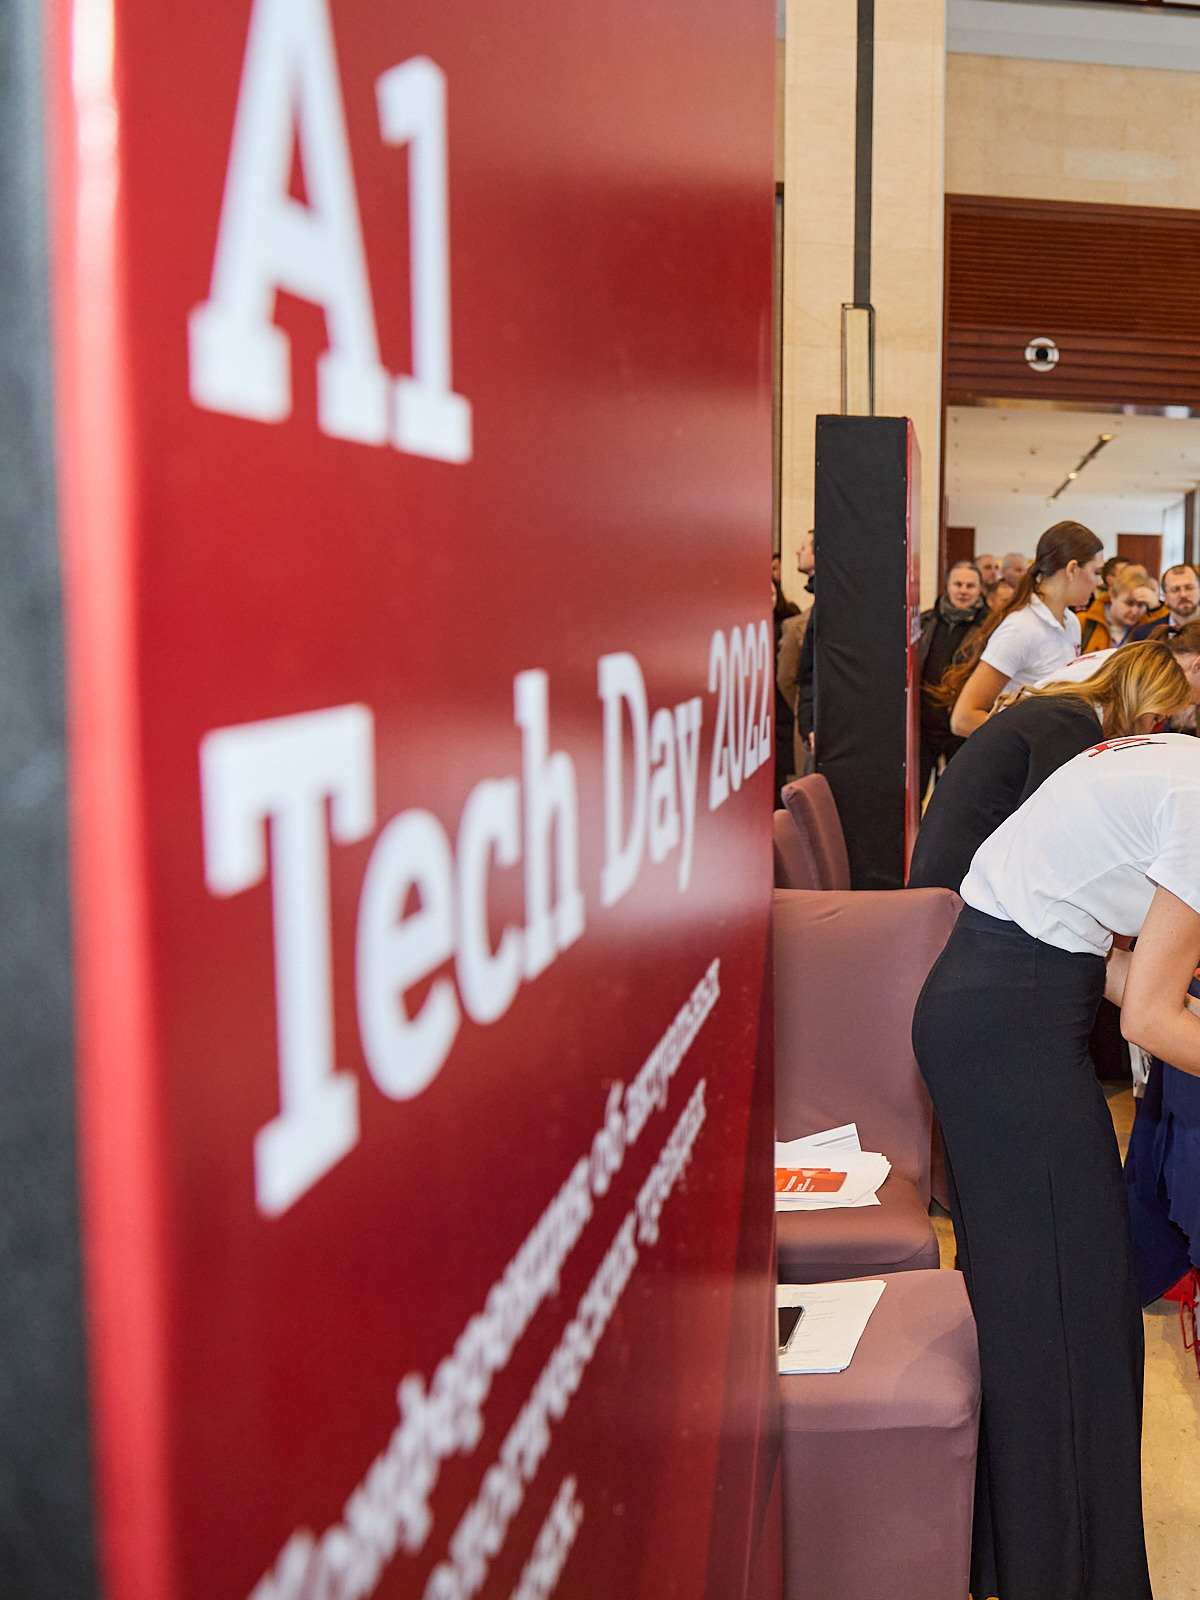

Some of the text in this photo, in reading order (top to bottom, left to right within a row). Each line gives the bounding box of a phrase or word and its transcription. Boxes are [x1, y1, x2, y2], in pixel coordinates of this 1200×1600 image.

[188, 0, 472, 465] A1
[200, 668, 586, 1221] Tech
[598, 651, 703, 908] Day
[708, 619, 772, 811] 2022
